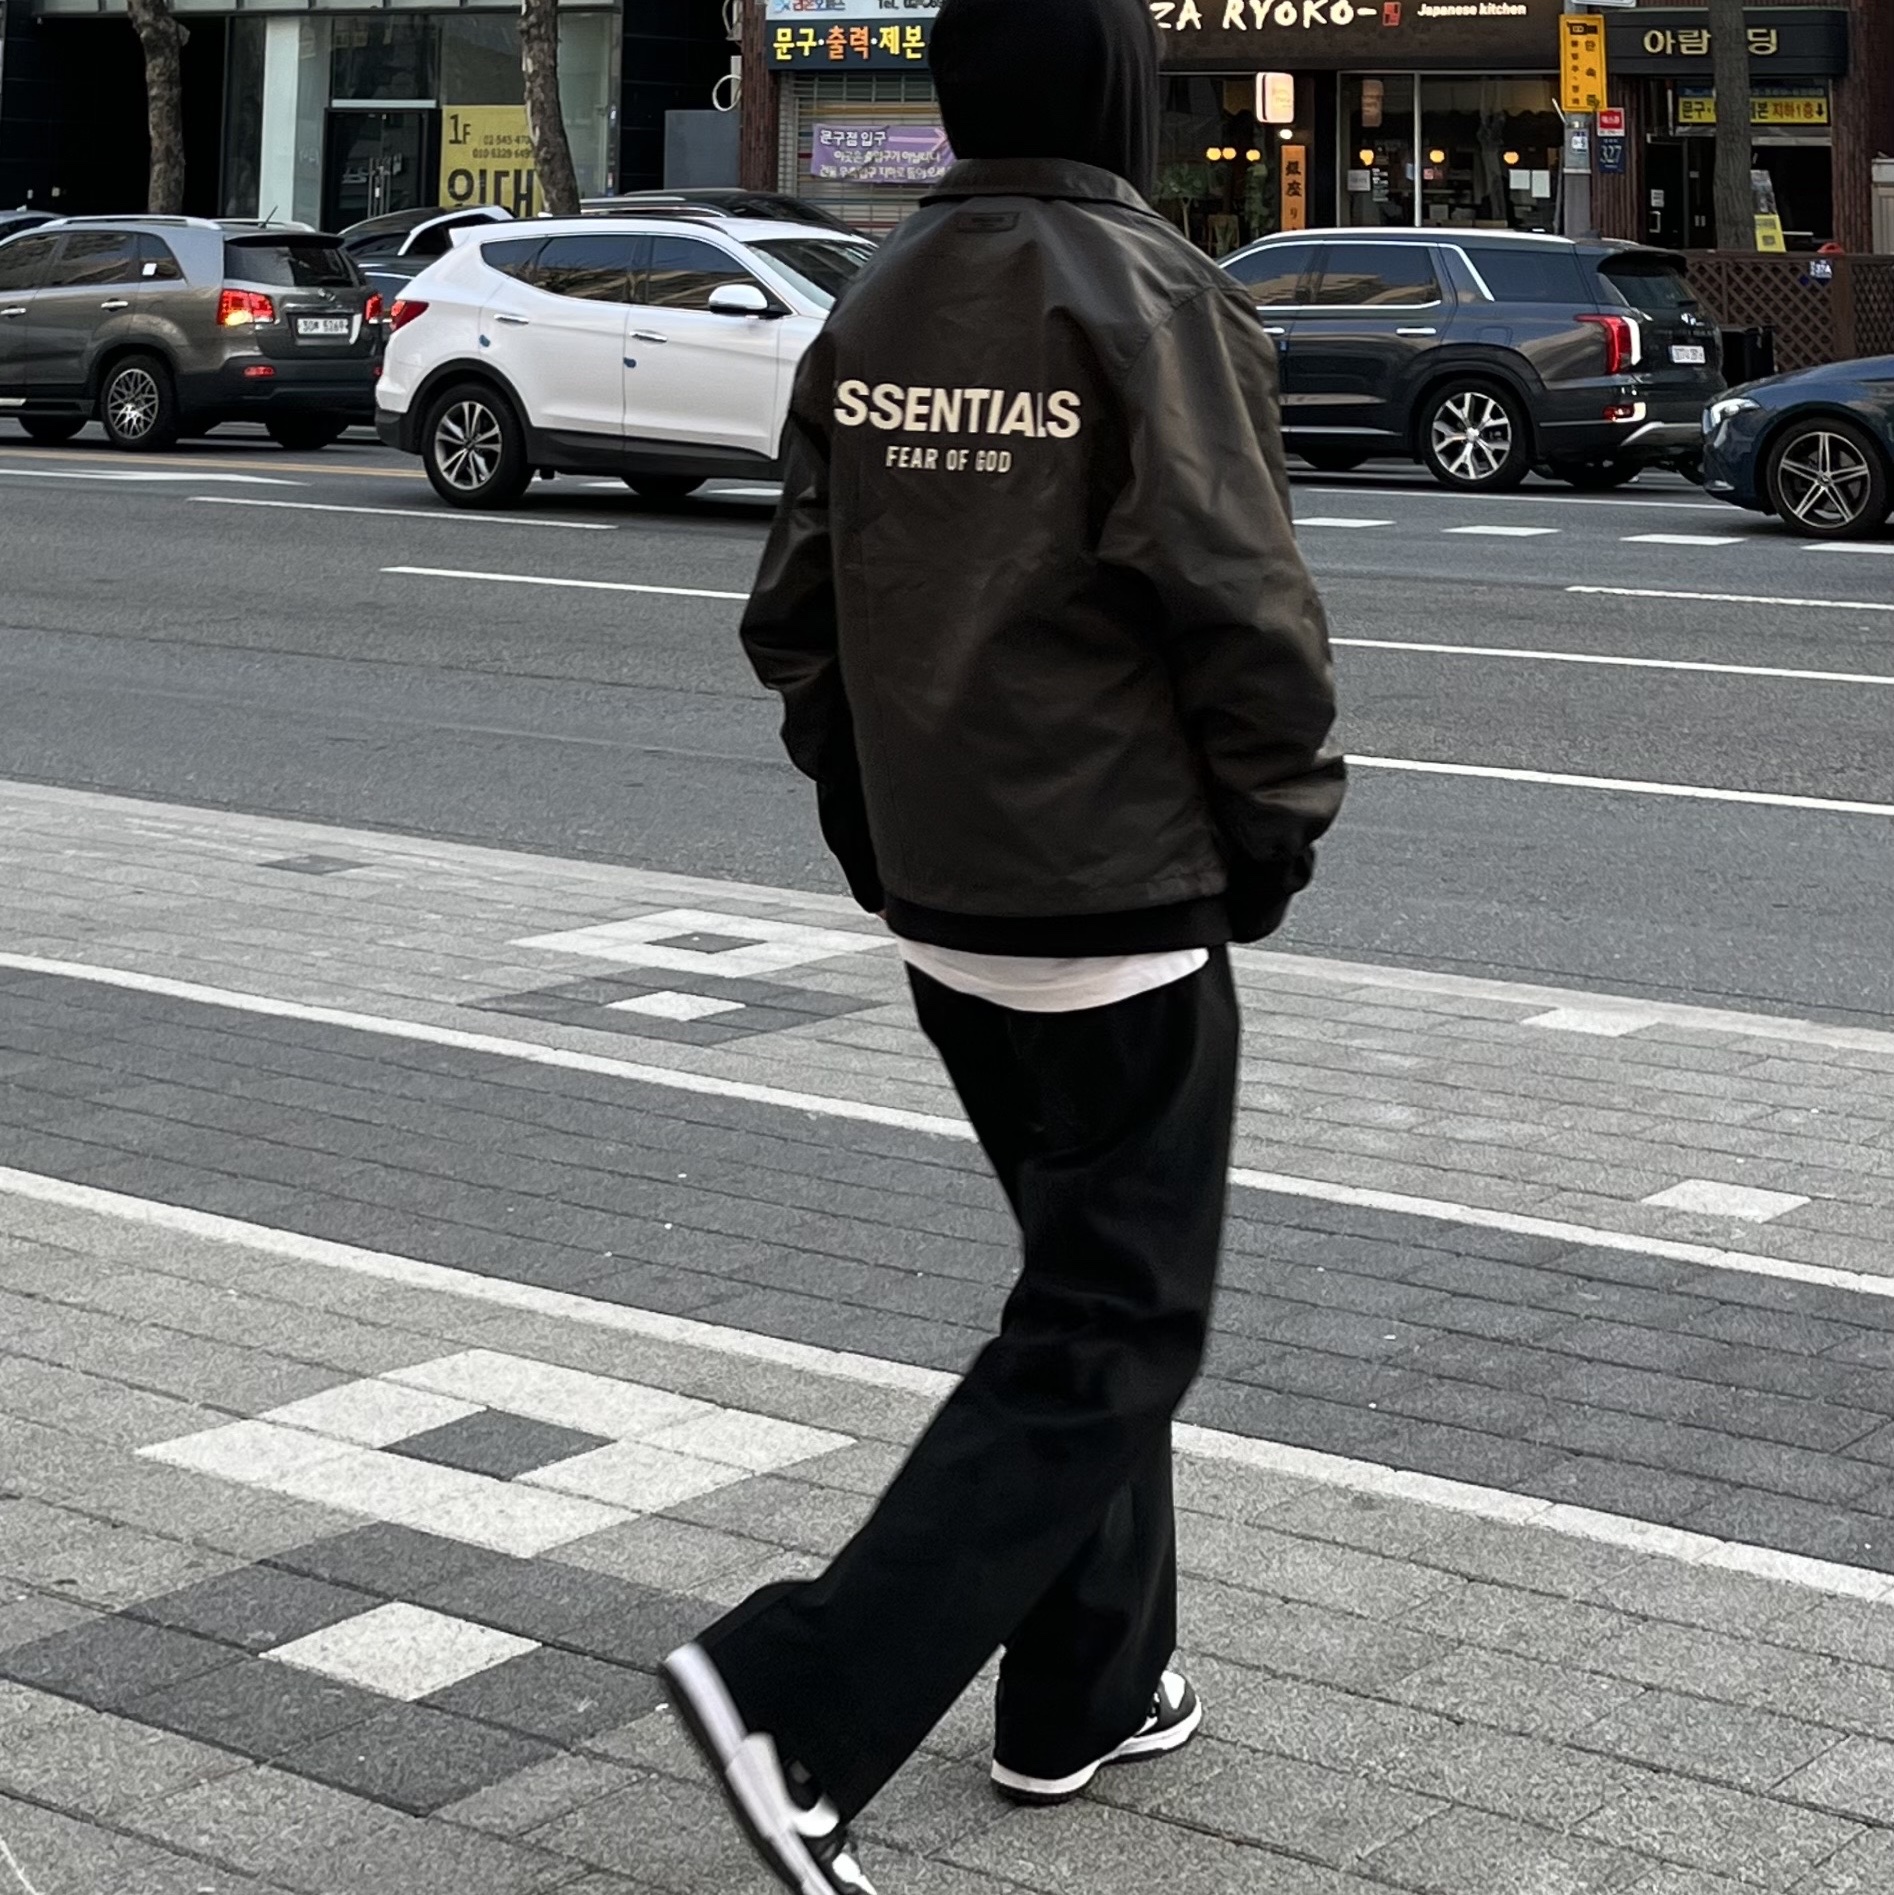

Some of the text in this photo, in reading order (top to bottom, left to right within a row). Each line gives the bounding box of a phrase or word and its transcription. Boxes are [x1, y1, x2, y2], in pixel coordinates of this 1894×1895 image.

[1150, 0, 1202, 31] ZA
[1417, 3, 1478, 18] Japanese
[1479, 2, 1527, 16] kitchen
[773, 25, 926, 61] 문구·출력·제본
[1643, 28, 1779, 55] 아람딩
[448, 113, 471, 146] 1F
[483, 135, 494, 146] 02
[860, 131, 886, 147] 입구
[472, 148, 488, 159] 010
[834, 379, 1082, 439] SSENTIALS
[885, 445, 1013, 473] FEAR OF GOD
